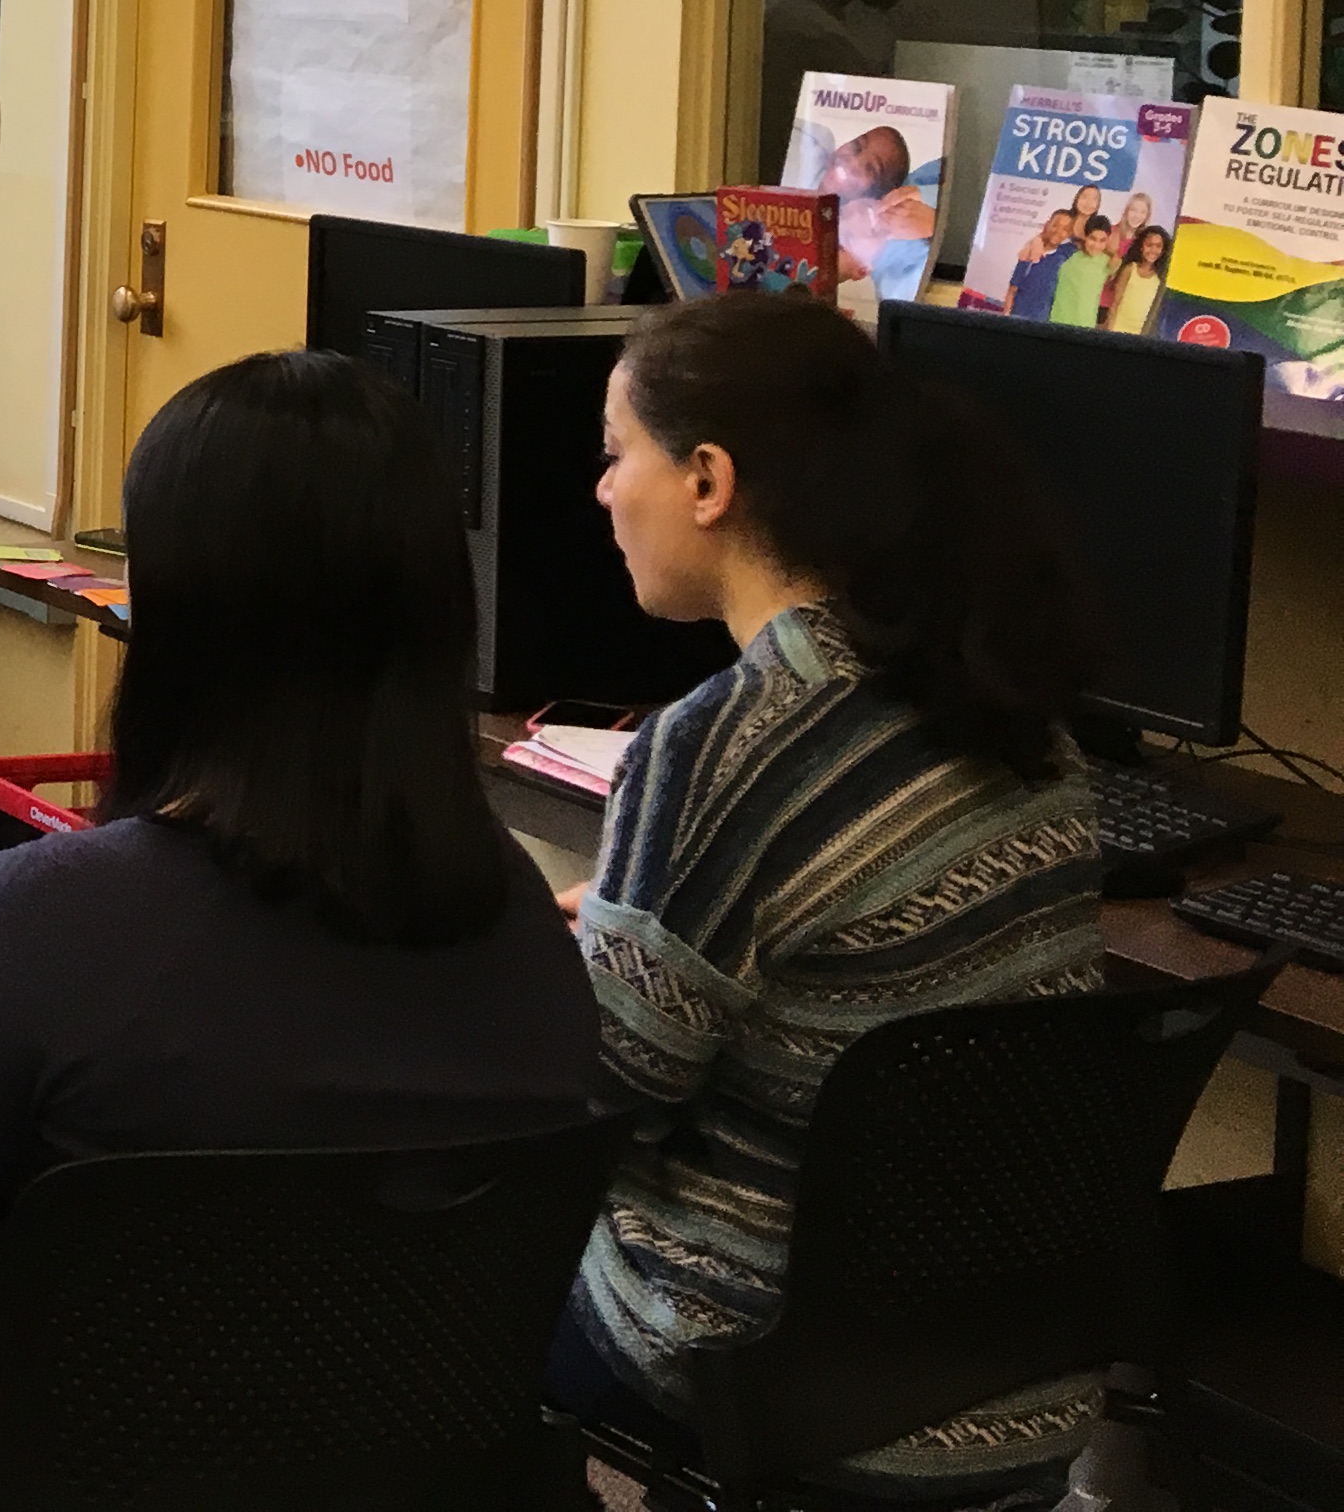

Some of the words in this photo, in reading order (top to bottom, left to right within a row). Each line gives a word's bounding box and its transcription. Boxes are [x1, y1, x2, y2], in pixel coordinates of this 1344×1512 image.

[1013, 113, 1129, 150] STRONG
[1237, 112, 1258, 124] THE
[305, 148, 337, 176] NO
[343, 154, 394, 183] Food
[1018, 141, 1111, 182] KIDS
[722, 194, 813, 245] Sleeping
